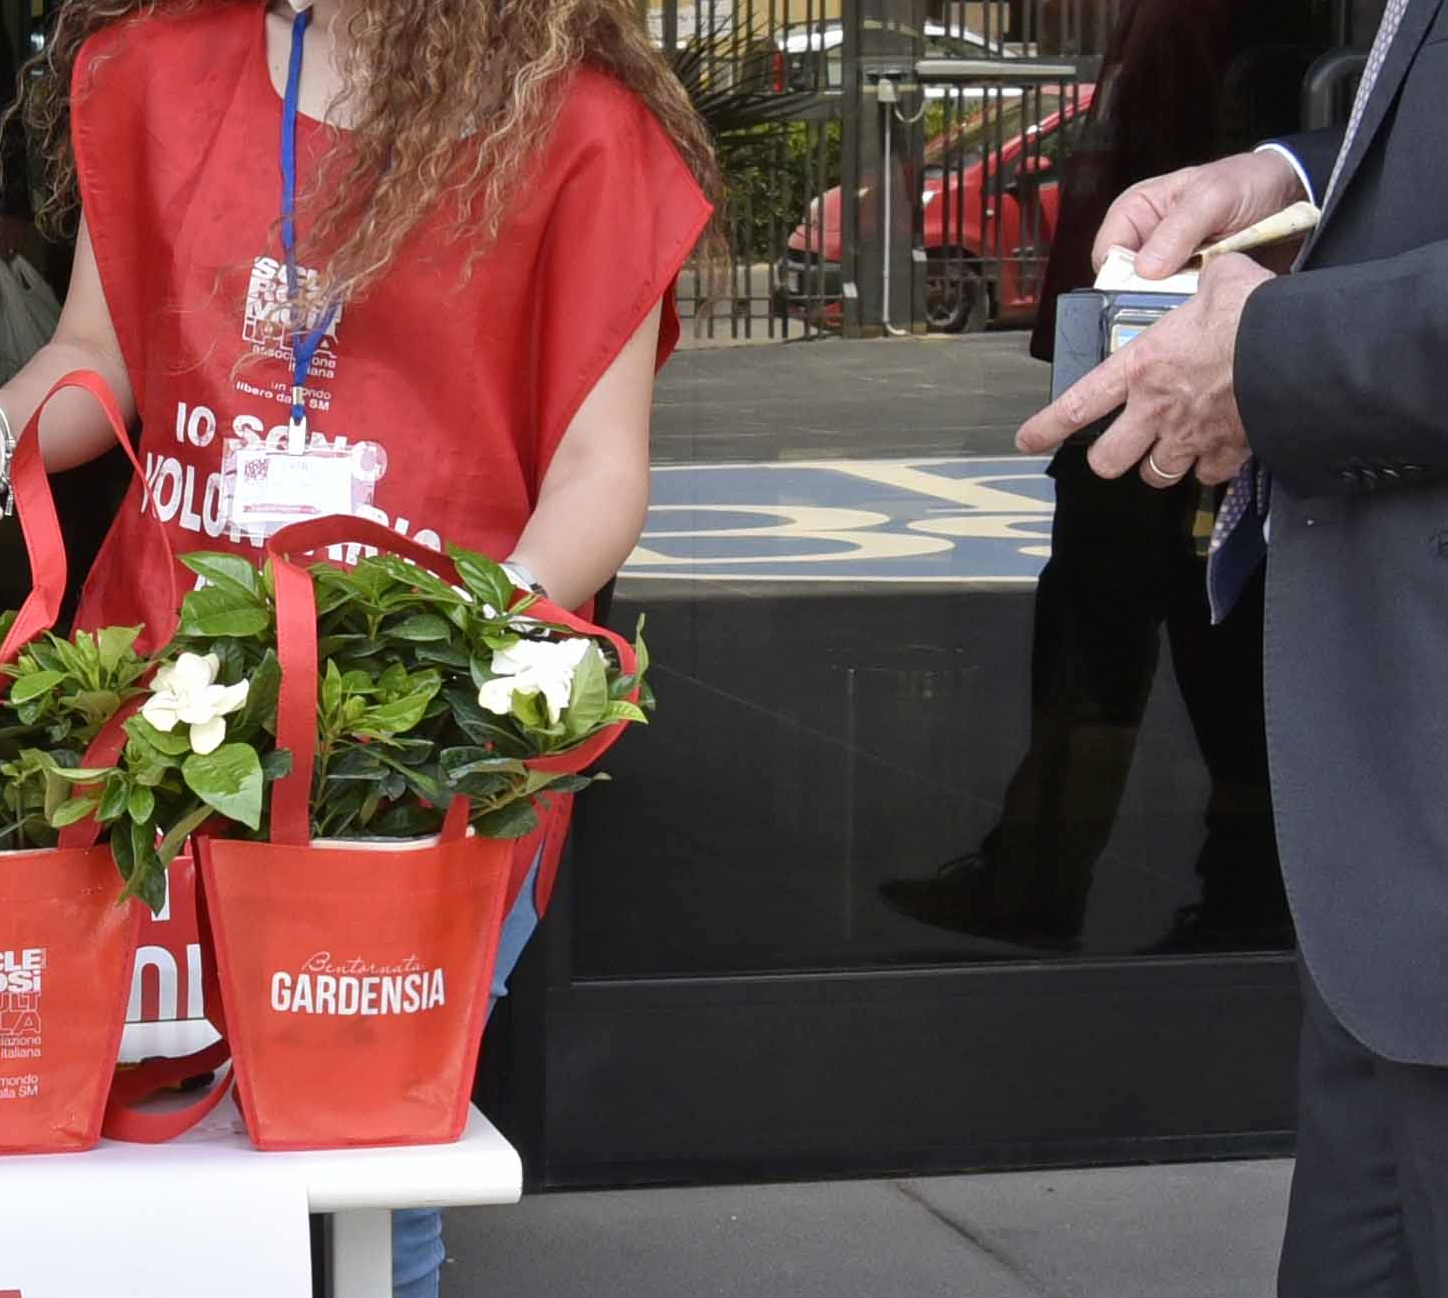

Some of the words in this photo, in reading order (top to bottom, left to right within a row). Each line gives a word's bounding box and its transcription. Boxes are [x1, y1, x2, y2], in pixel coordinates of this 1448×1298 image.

[236, 380, 274, 400] libero
[309, 398, 331, 412] SM
[176, 402, 217, 447] IO
[302, 950, 425, 975] Bentornata
[271, 967, 446, 1016] GARDENSIA
[1, 1047, 42, 1059] italiana
[18, 1085, 38, 1097] SM
